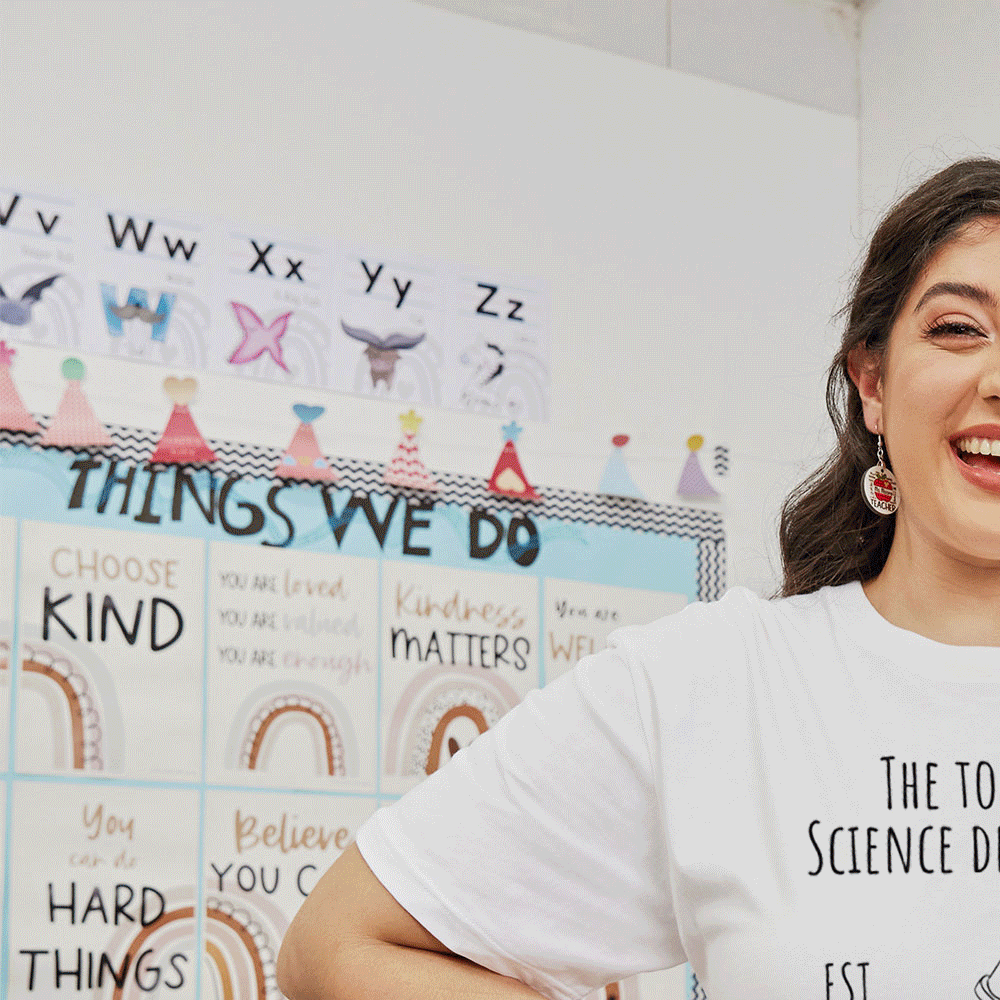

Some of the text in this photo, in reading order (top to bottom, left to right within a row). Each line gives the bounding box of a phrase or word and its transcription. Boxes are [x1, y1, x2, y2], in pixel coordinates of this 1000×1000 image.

[107, 212, 197, 262] W w
[249, 240, 305, 283] X x
[360, 259, 412, 309] Y y
[475, 281, 525, 323] Z z
[67, 459, 542, 568] THINGS WE DO
[51, 547, 180, 588] CHOOSE
[219, 573, 247, 590] YOU
[42, 586, 184, 651] KIND
[396, 584, 525, 629] Kindness
[83, 803, 135, 840] You
[234, 809, 350, 854] Believe
[211, 863, 279, 894] YOU
[48, 882, 165, 927] HARD
[19, 948, 189, 993] THINGS
